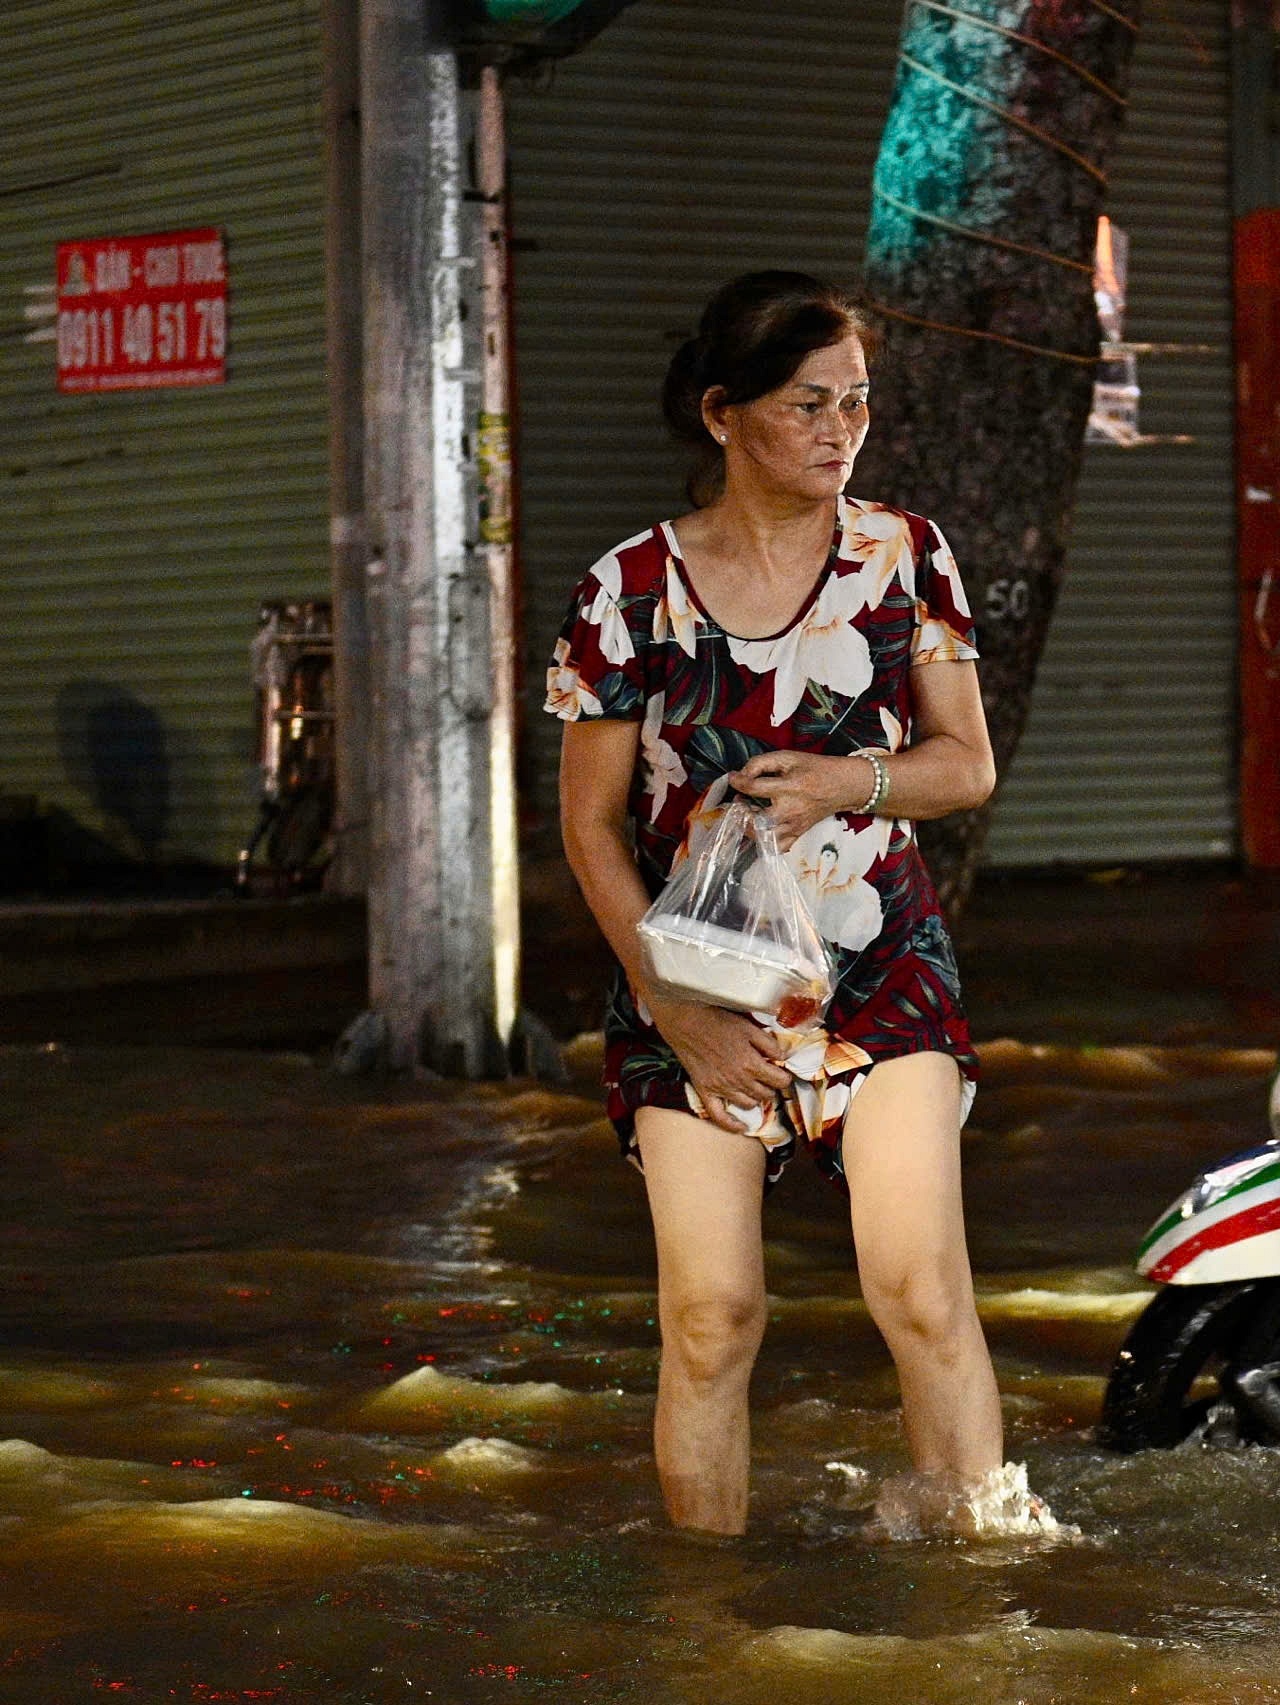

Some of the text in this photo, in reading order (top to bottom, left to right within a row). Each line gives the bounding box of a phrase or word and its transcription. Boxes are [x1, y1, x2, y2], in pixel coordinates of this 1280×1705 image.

[57, 308, 114, 370] 0911
[121, 303, 153, 364] 40
[157, 301, 187, 362] 51
[985, 578, 1028, 620] 50
